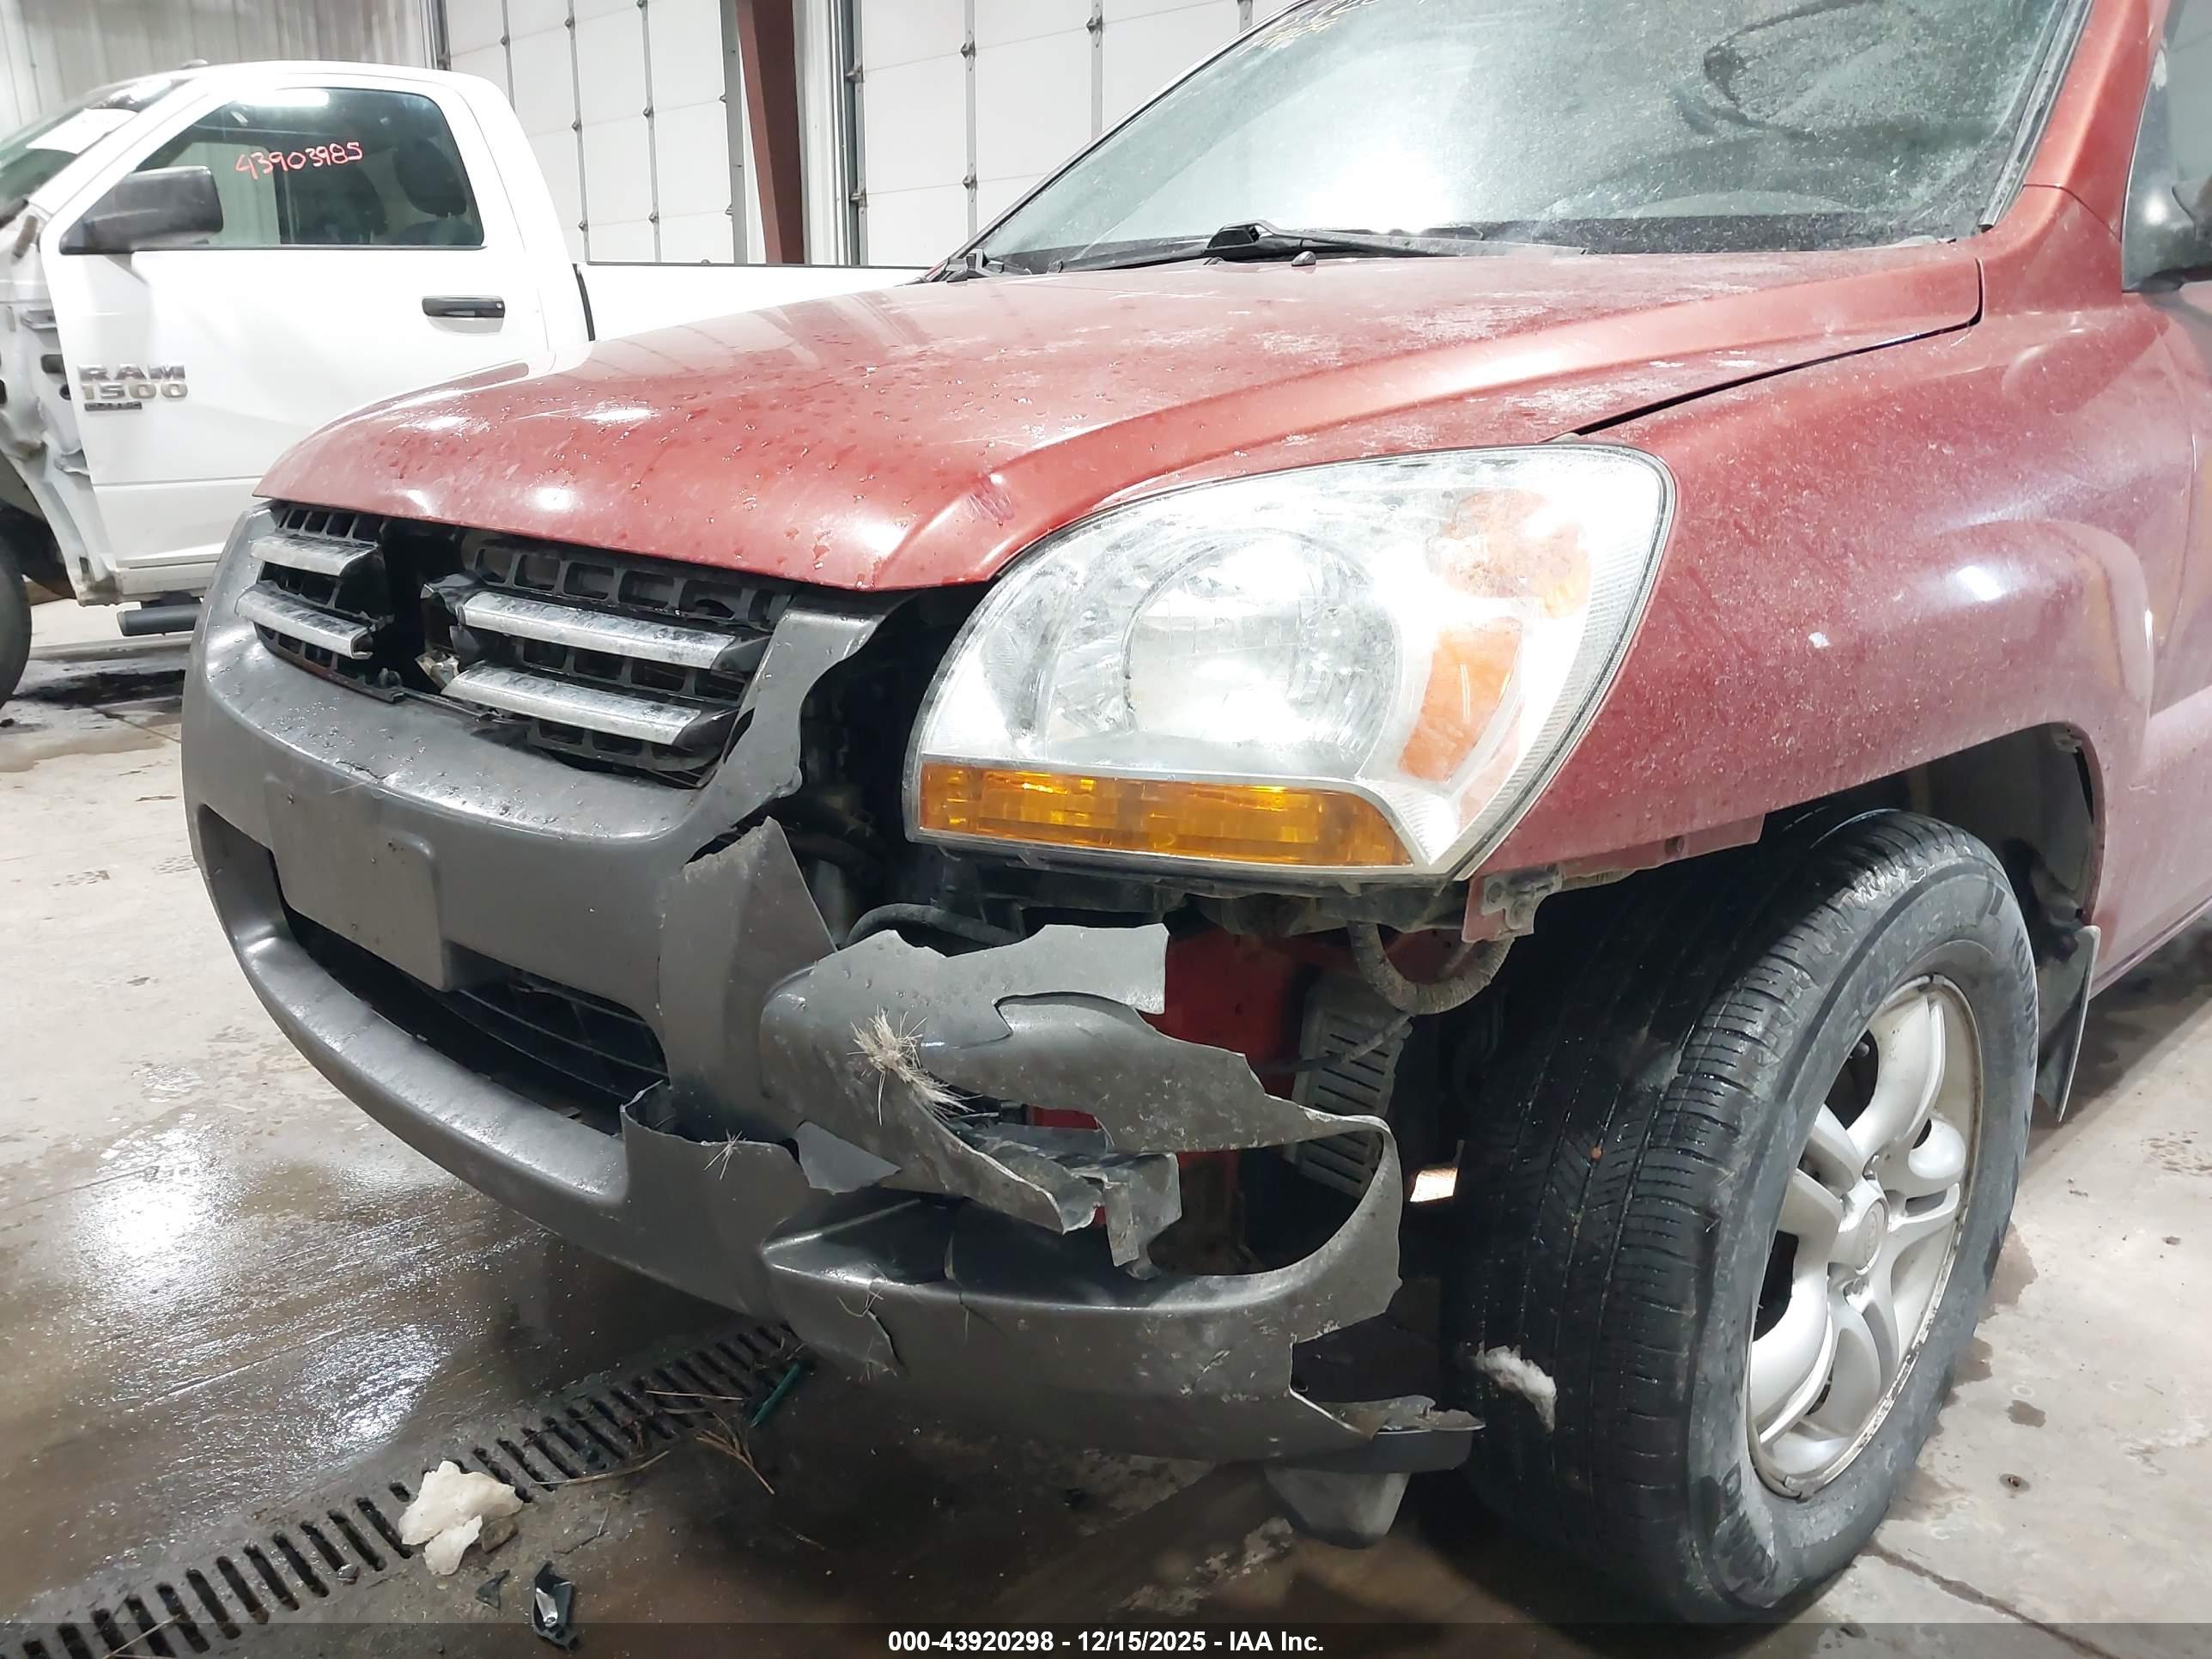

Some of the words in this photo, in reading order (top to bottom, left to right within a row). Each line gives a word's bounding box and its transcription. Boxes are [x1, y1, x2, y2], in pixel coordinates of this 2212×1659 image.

[234, 142, 363, 180] 43903985
[78, 364, 185, 381] RAM
[82, 382, 189, 400] 1500
